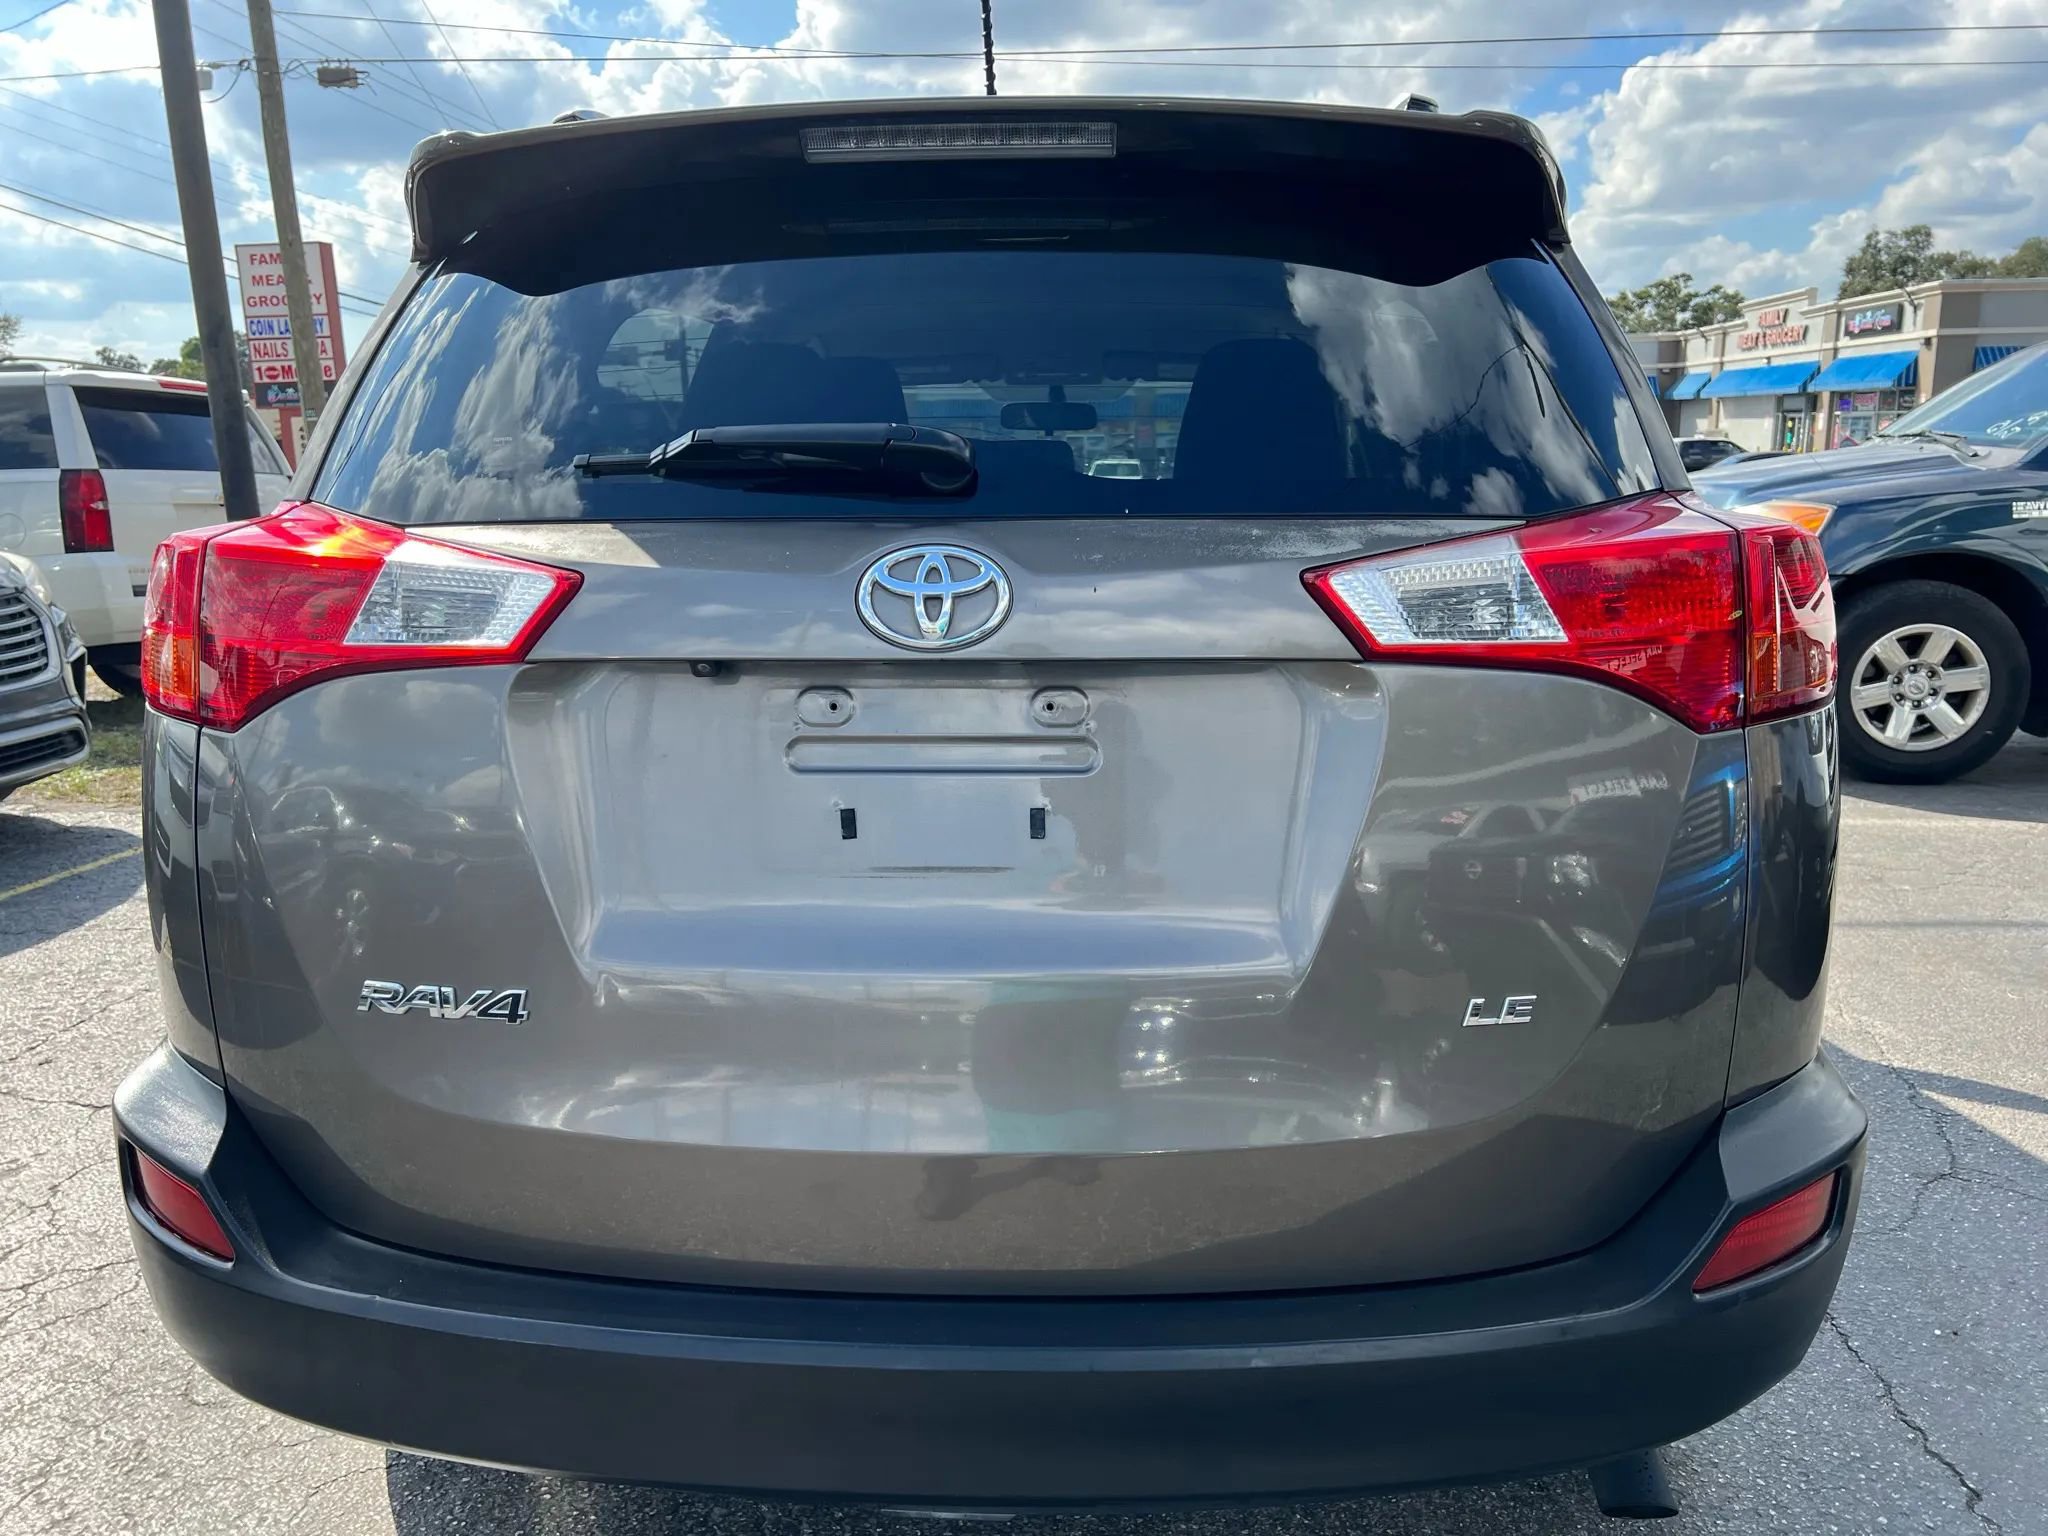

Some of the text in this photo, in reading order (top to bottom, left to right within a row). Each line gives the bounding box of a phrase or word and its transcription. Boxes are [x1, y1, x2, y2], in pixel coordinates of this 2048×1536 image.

[251, 274, 287, 287] MEA
[249, 319, 276, 336] COIN
[252, 342, 289, 359] NAILS
[357, 980, 528, 1025] RAV4
[1463, 995, 1537, 1026] LE
